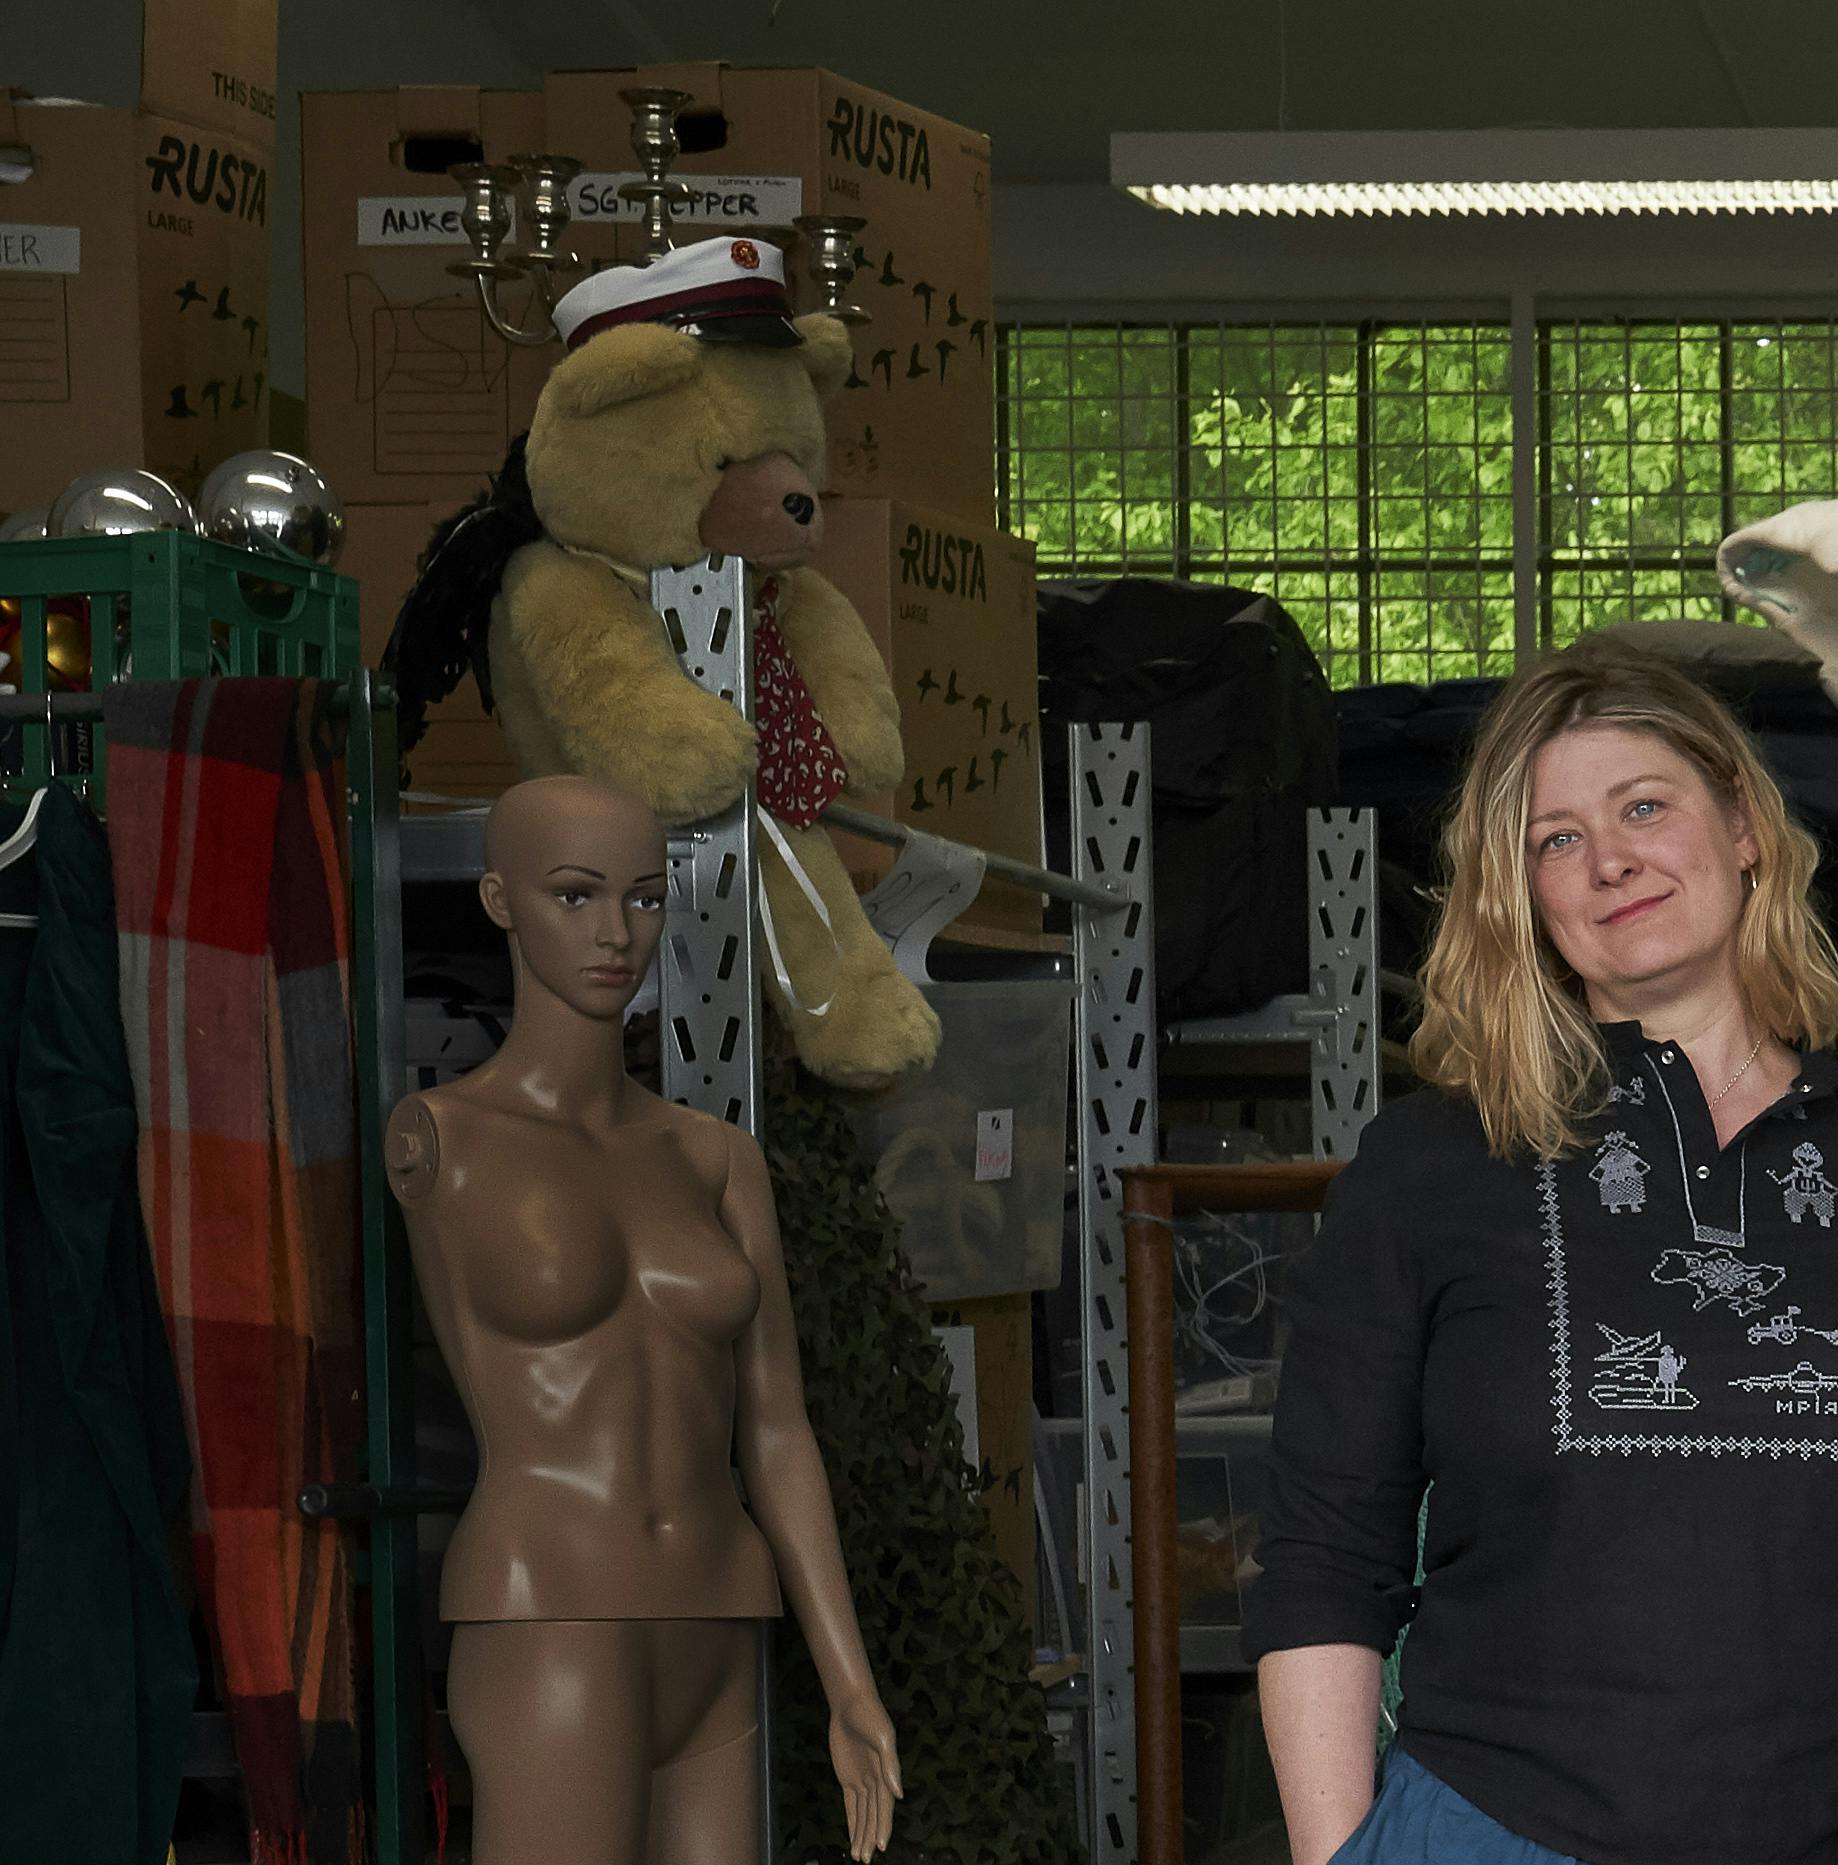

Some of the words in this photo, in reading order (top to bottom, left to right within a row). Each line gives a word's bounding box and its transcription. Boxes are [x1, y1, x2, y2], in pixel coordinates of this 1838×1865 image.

[212, 72, 246, 106] THIS
[250, 86, 276, 119] SIDE
[827, 97, 931, 190] RUSTA
[146, 136, 266, 227] RUSTA
[670, 191, 760, 216] EPPER
[148, 210, 194, 237] LARGE
[0, 234, 41, 264] ER
[899, 523, 987, 603] RUSTA
